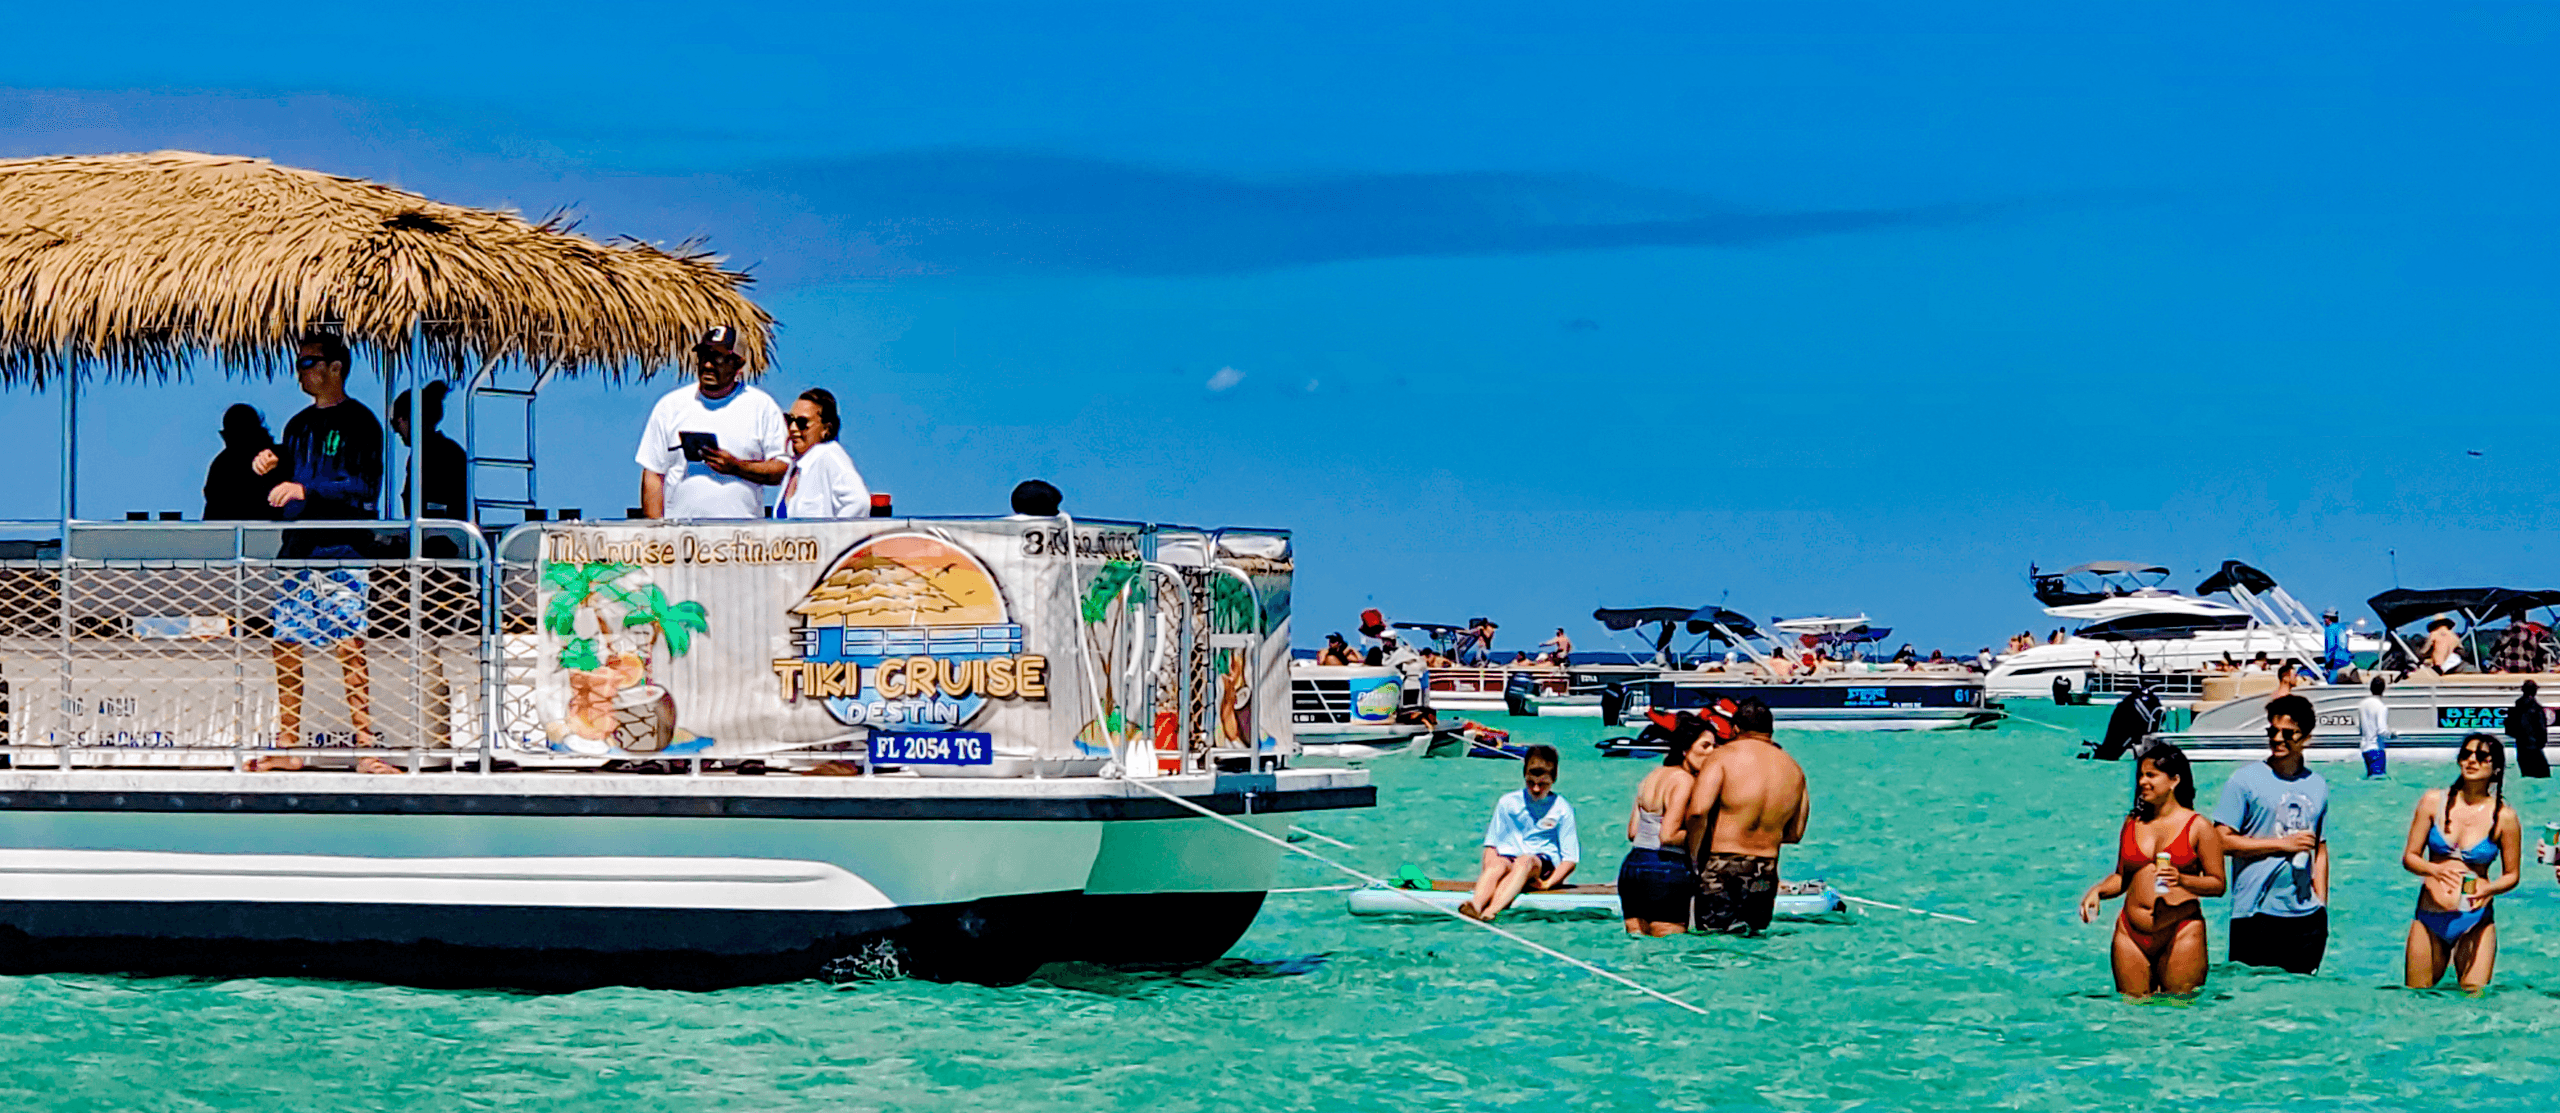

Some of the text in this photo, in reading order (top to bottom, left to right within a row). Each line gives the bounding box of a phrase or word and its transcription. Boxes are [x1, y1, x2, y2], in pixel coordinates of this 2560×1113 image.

[773, 655, 1048, 701] TIKI CRUISE
[845, 700, 960, 726] DESTIN
[2440, 718, 2506, 728] WEEKE
[2446, 707, 2509, 718] BEAC
[876, 736, 982, 760] FL 2054 TG
